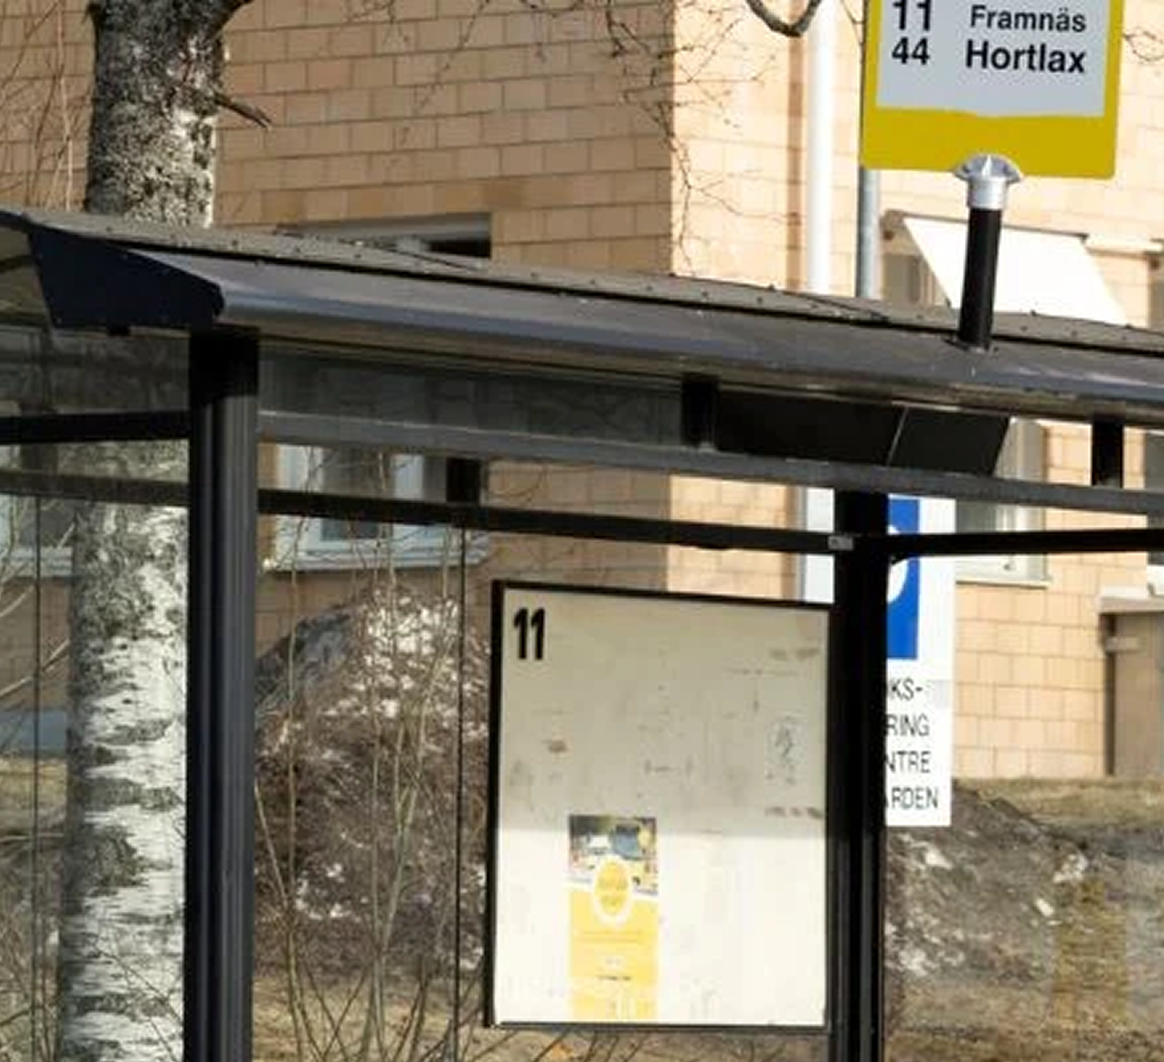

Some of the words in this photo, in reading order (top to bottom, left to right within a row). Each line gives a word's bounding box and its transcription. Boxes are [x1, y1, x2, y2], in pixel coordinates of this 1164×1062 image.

[893, 0, 931, 31] 11
[970, 5, 1086, 32] Framnäs
[892, 37, 930, 65] 44
[965, 39, 1085, 73] Hortlax
[513, 608, 546, 660] 11
